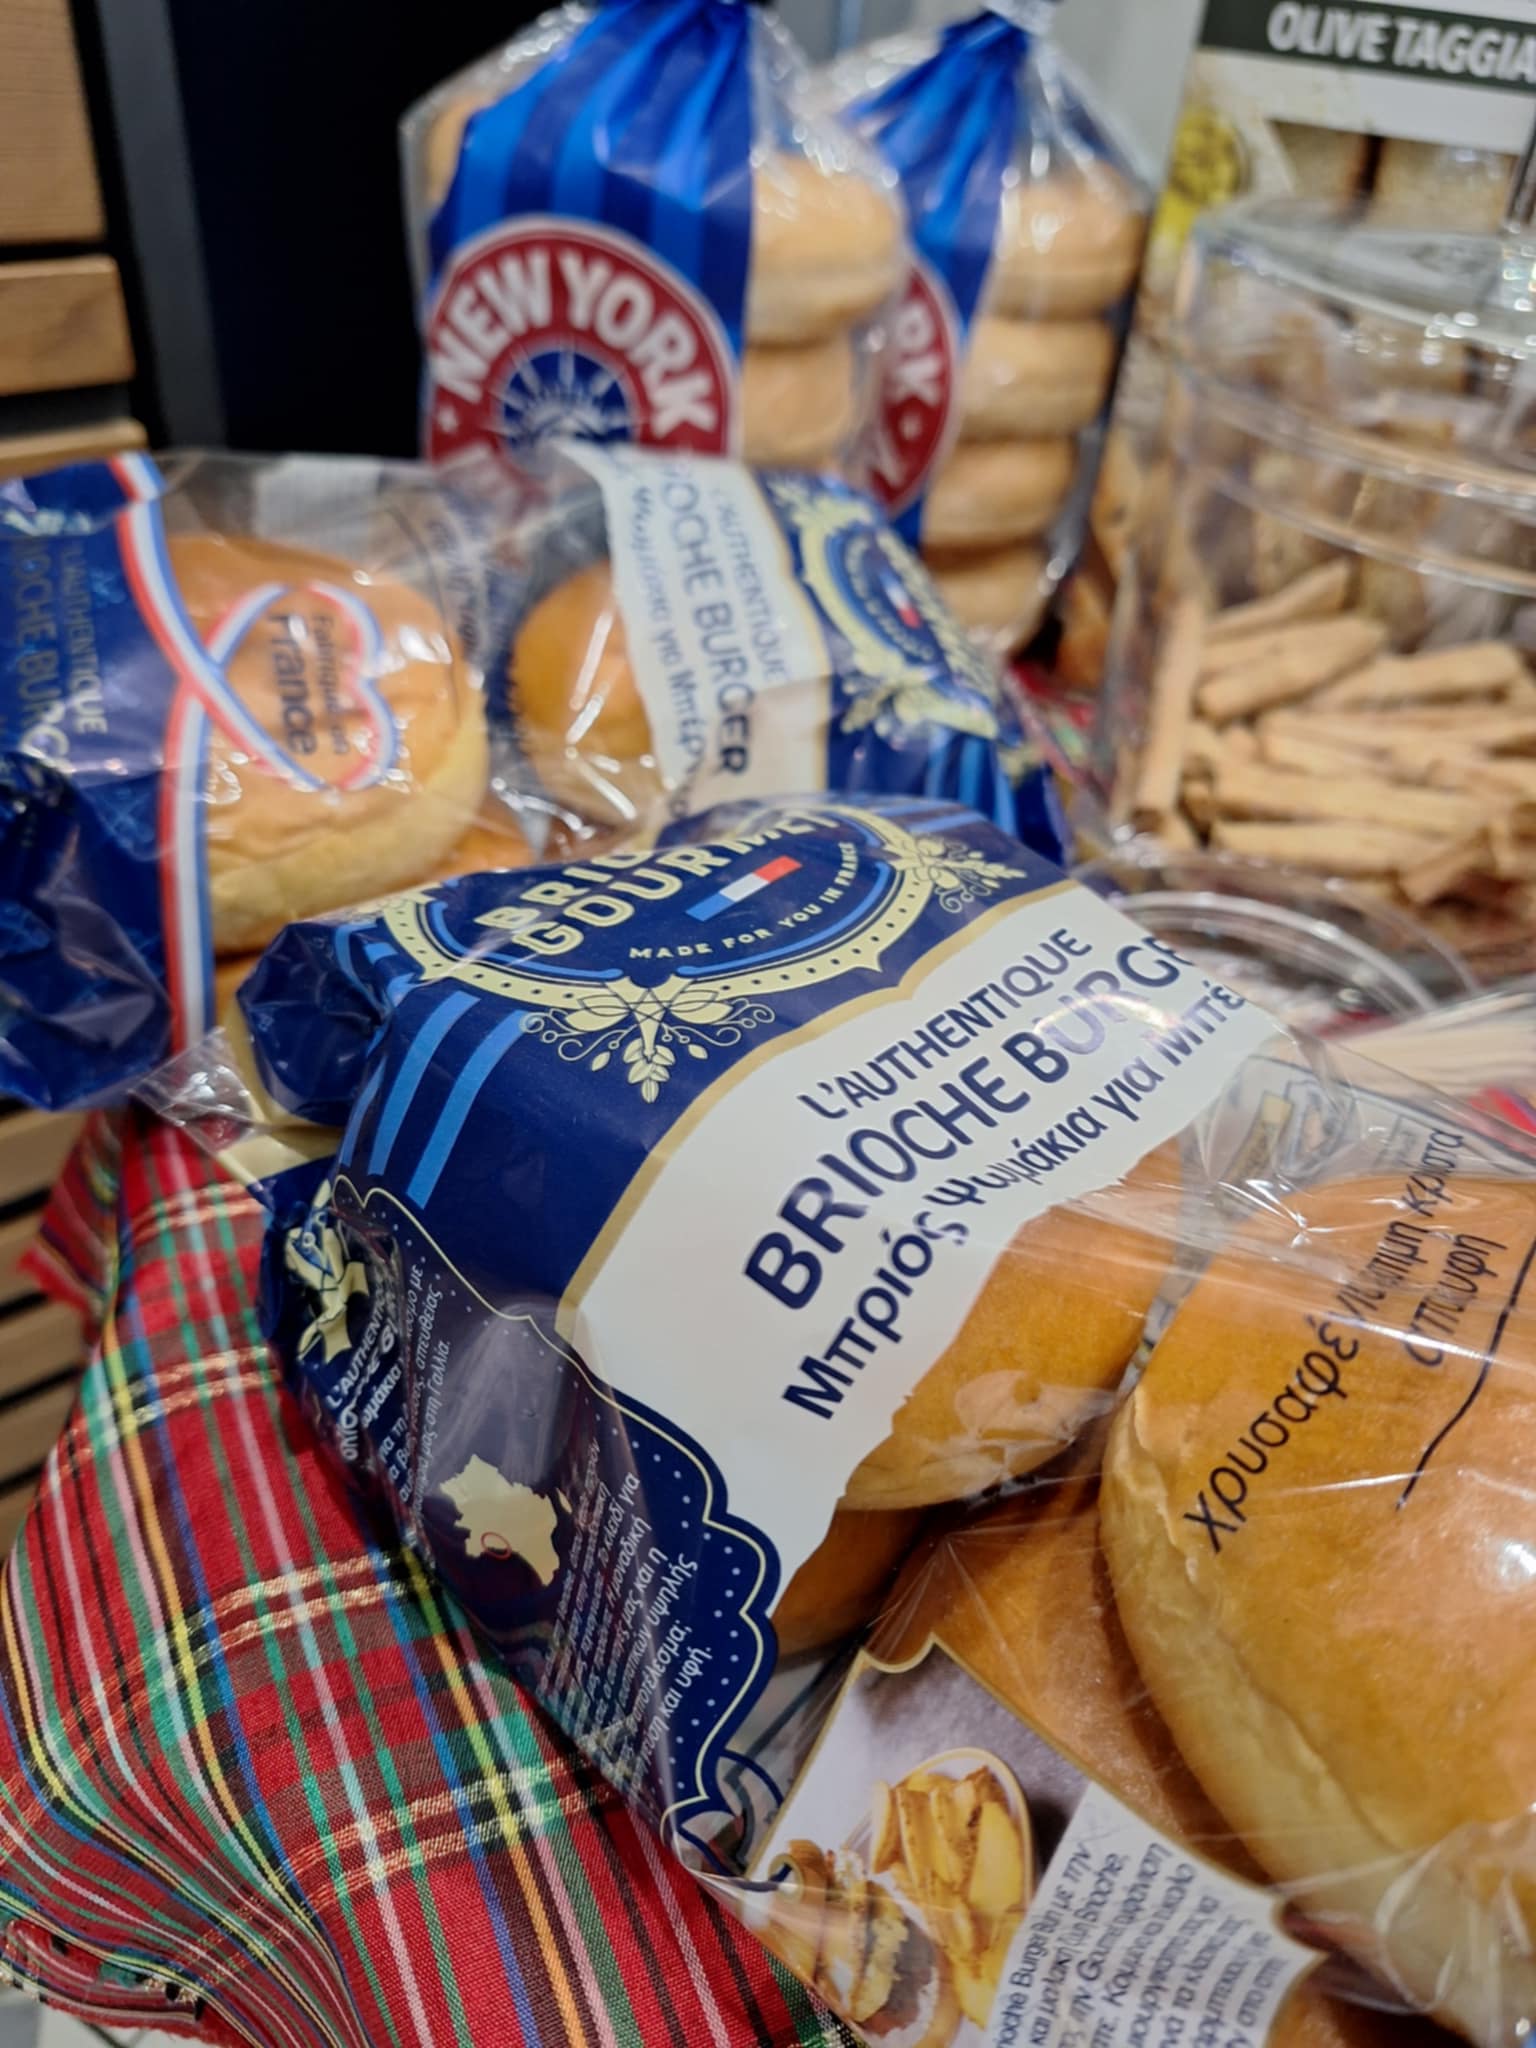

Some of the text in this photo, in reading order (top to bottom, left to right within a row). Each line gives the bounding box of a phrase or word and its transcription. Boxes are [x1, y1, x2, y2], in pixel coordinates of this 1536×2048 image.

[1267, 2, 1391, 62] OLIVE
[433, 248, 719, 438] NEW YORK
[693, 601, 757, 777] BURGER
[474, 850, 653, 930] BRIO
[629, 842, 860, 959] MADE FOR YOU IN FRANCE
[796, 927, 1094, 1120] L'AUTHENTIQUE
[743, 1056, 1031, 1311] BRIOCHE
[781, 1210, 971, 1421] Μπριός
[1089, 1056, 1166, 1123] για
[1140, 979, 1247, 1067] Μπέ
[416, 1283, 444, 1371] απευθείας
[426, 1340, 452, 1395] Γαλλία.
[360, 1363, 403, 1429] ωμάκια
[424, 1396, 443, 1426] στη
[618, 1472, 641, 1506] για
[611, 1513, 653, 1599] μοναδική
[622, 1589, 644, 1629] μας
[634, 1562, 656, 1593] και
[648, 1547, 669, 1565] η
[646, 1553, 698, 1627] υψηλής
[659, 1688, 683, 1719] και
[675, 1647, 713, 1689] υφή.
[1009, 1932, 1050, 1988] Burger
[1063, 1842, 1091, 1883] την
